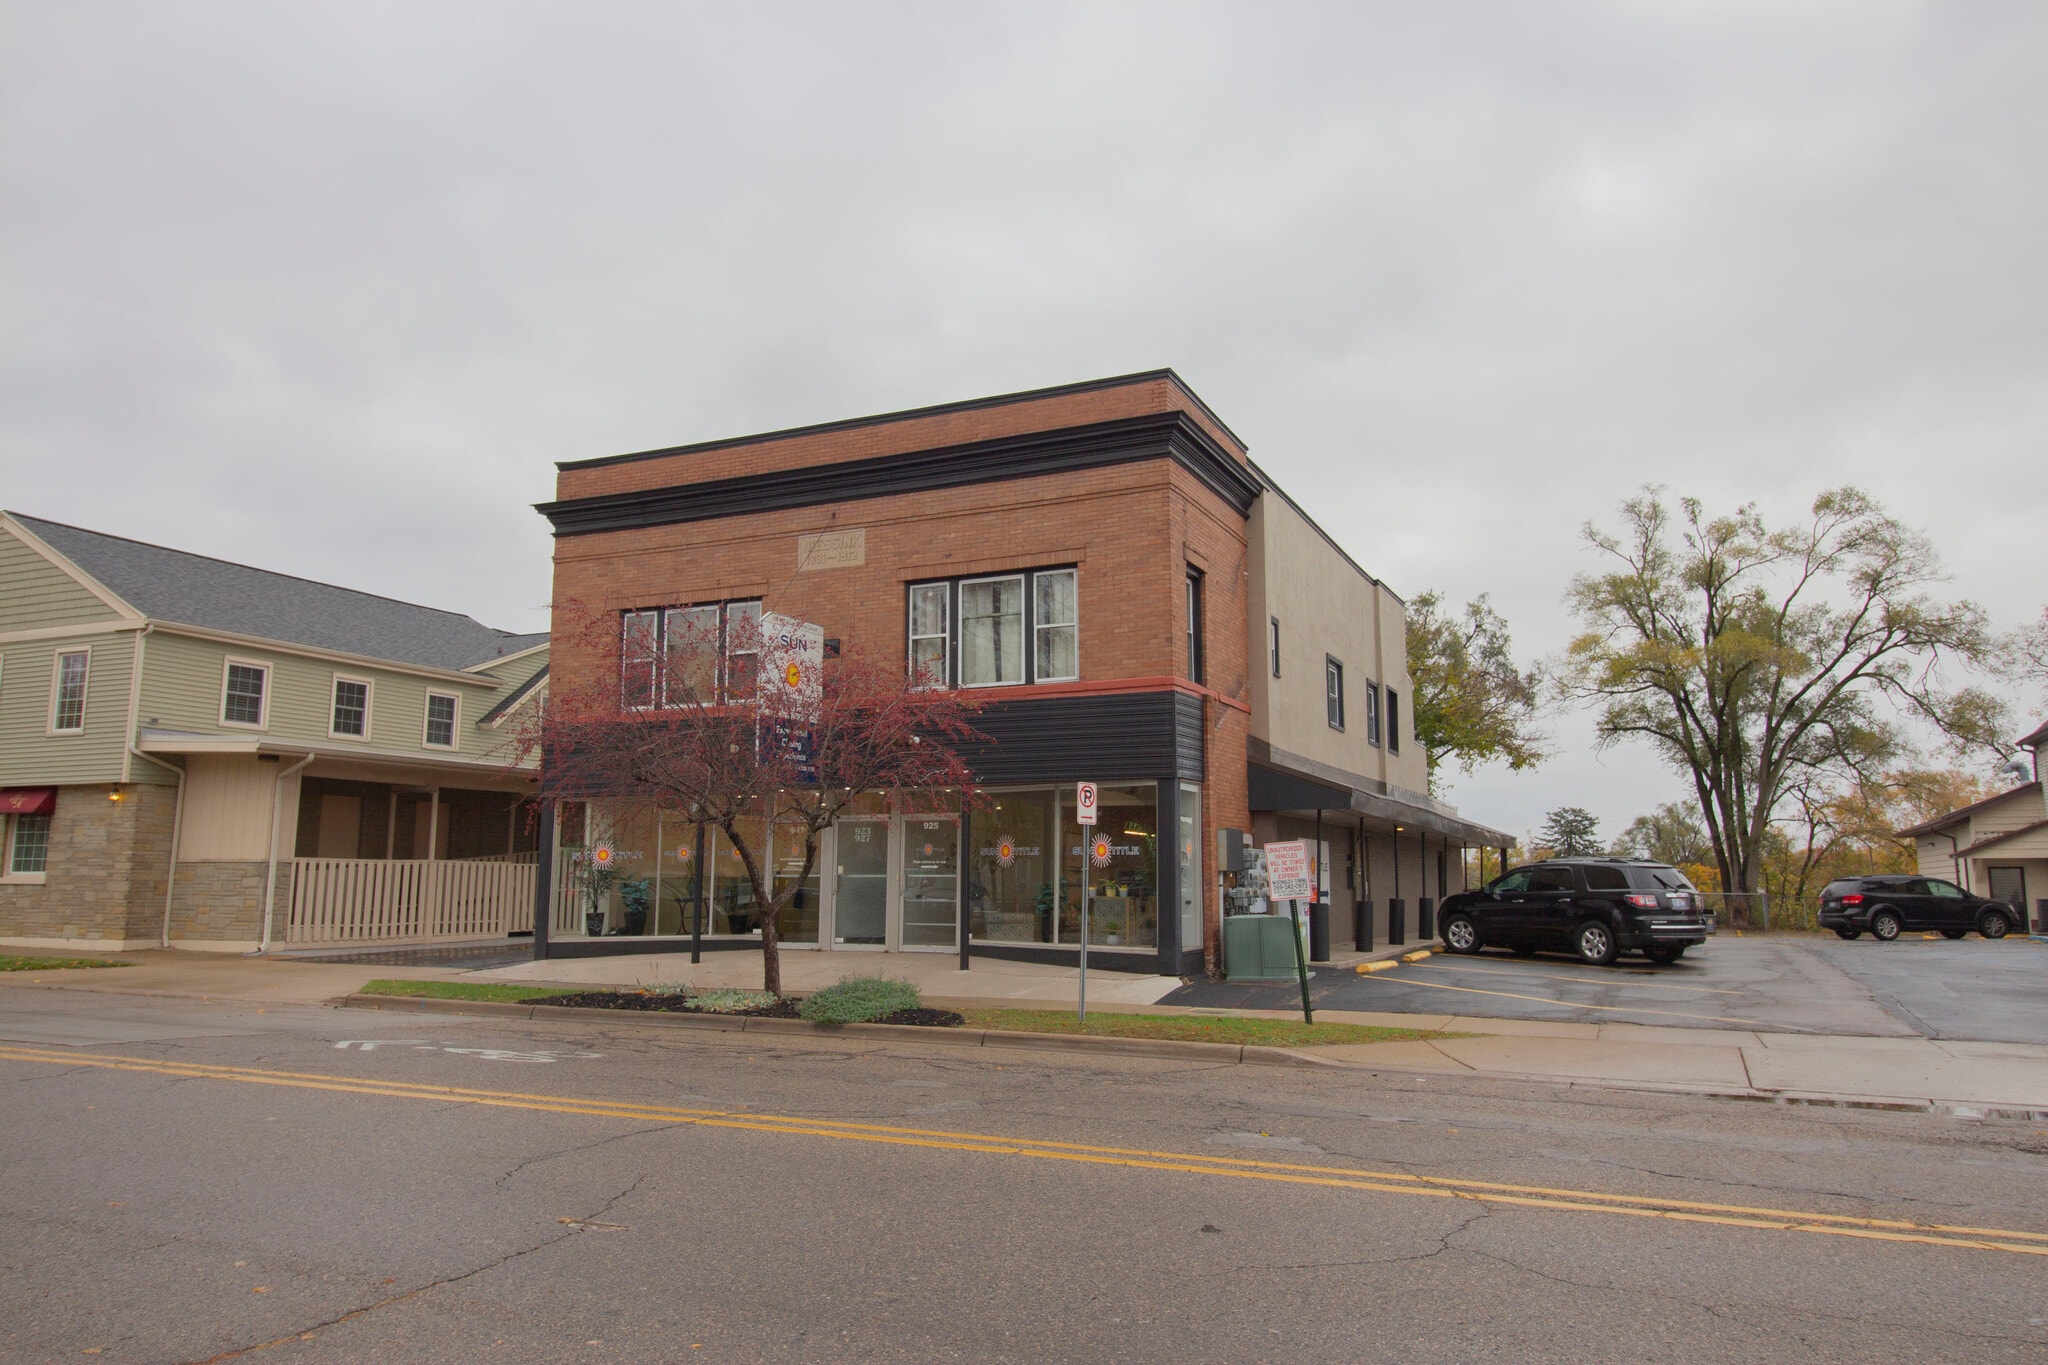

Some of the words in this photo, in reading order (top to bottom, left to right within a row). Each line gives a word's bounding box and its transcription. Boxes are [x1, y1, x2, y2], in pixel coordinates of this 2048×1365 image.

[781, 635, 807, 652] SUN
[854, 827, 872, 835] 923
[923, 822, 939, 830] 925
[980, 847, 998, 857] SUN
[1014, 847, 1040, 856] TITLE
[1110, 846, 1140, 856] TITLE
